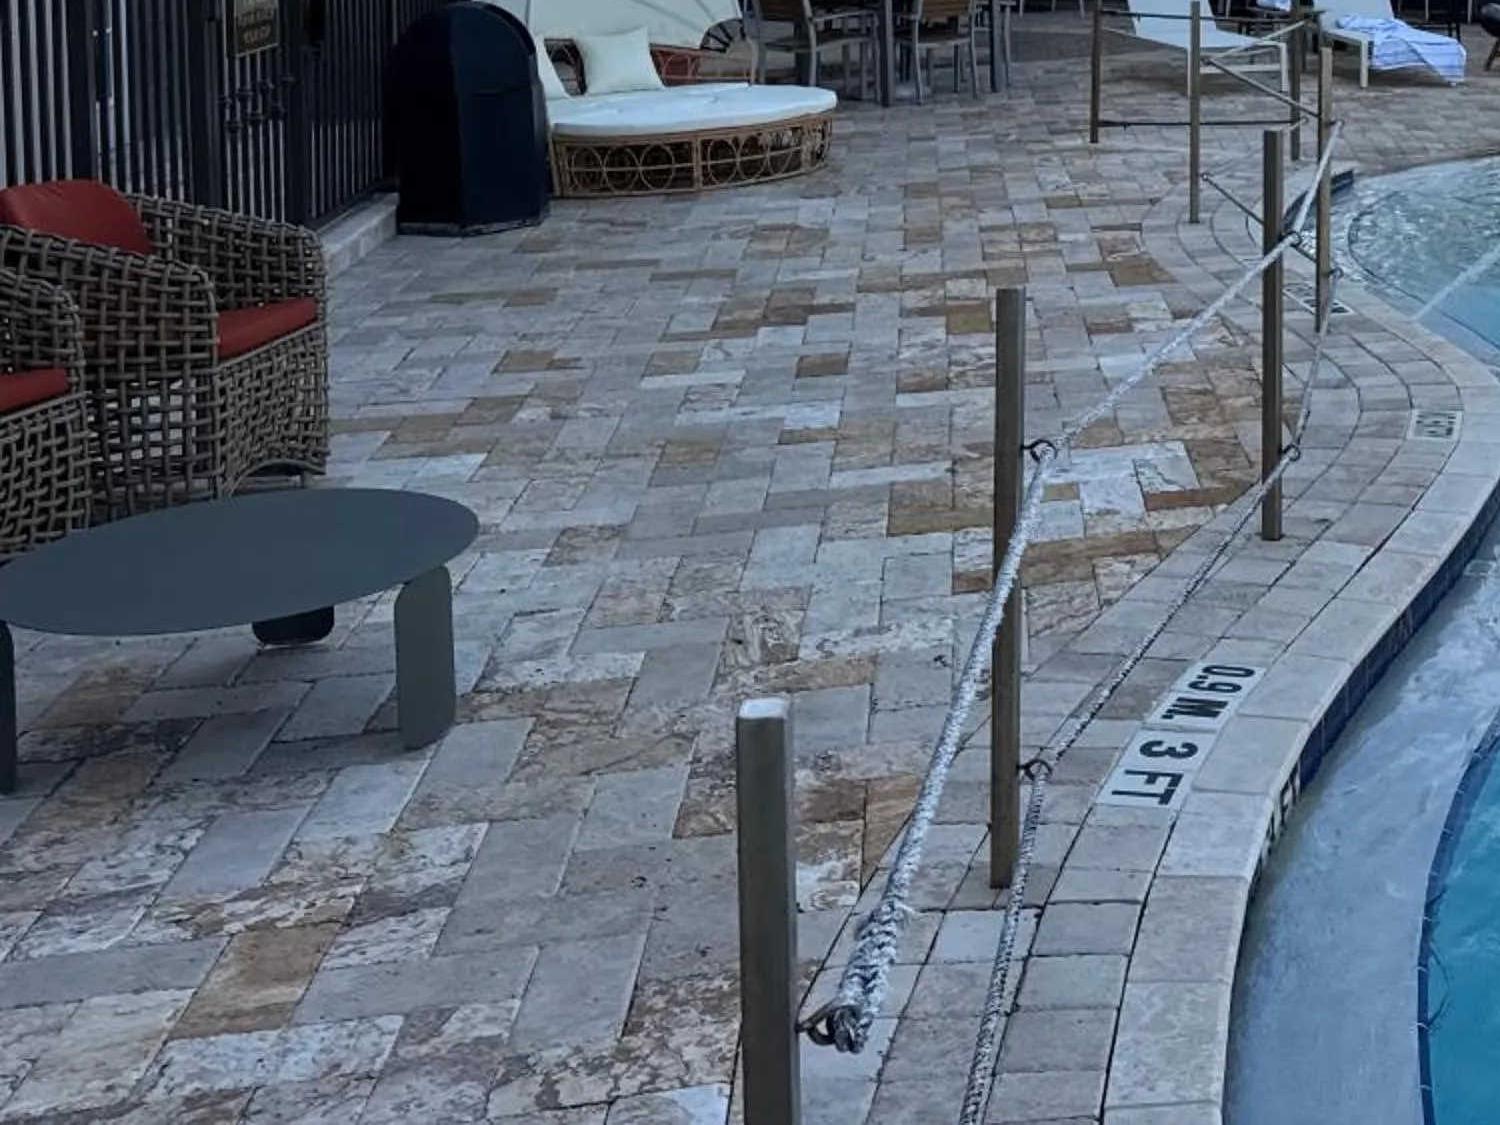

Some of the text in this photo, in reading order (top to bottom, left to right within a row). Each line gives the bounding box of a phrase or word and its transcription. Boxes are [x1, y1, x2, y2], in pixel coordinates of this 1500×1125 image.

[1188, 664, 1256, 694] 0.9
[1139, 739, 1199, 760] 3
[1111, 768, 1185, 806] FT
